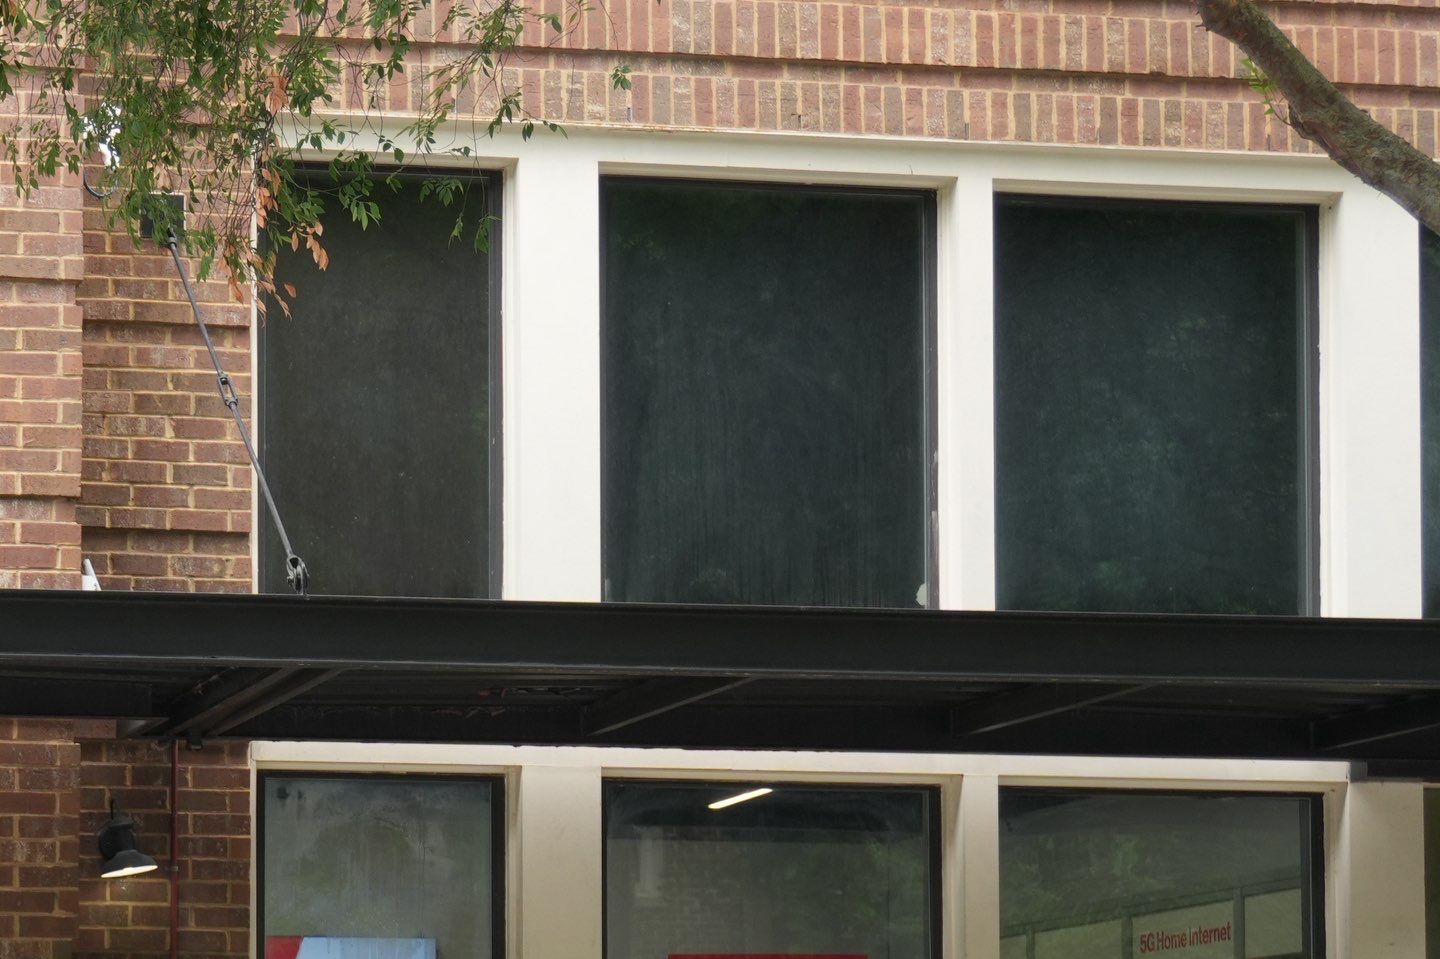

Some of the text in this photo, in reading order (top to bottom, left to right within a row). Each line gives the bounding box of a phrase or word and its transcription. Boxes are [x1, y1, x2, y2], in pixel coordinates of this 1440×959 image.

[1140, 922, 1232, 953] 5G Home Internet
